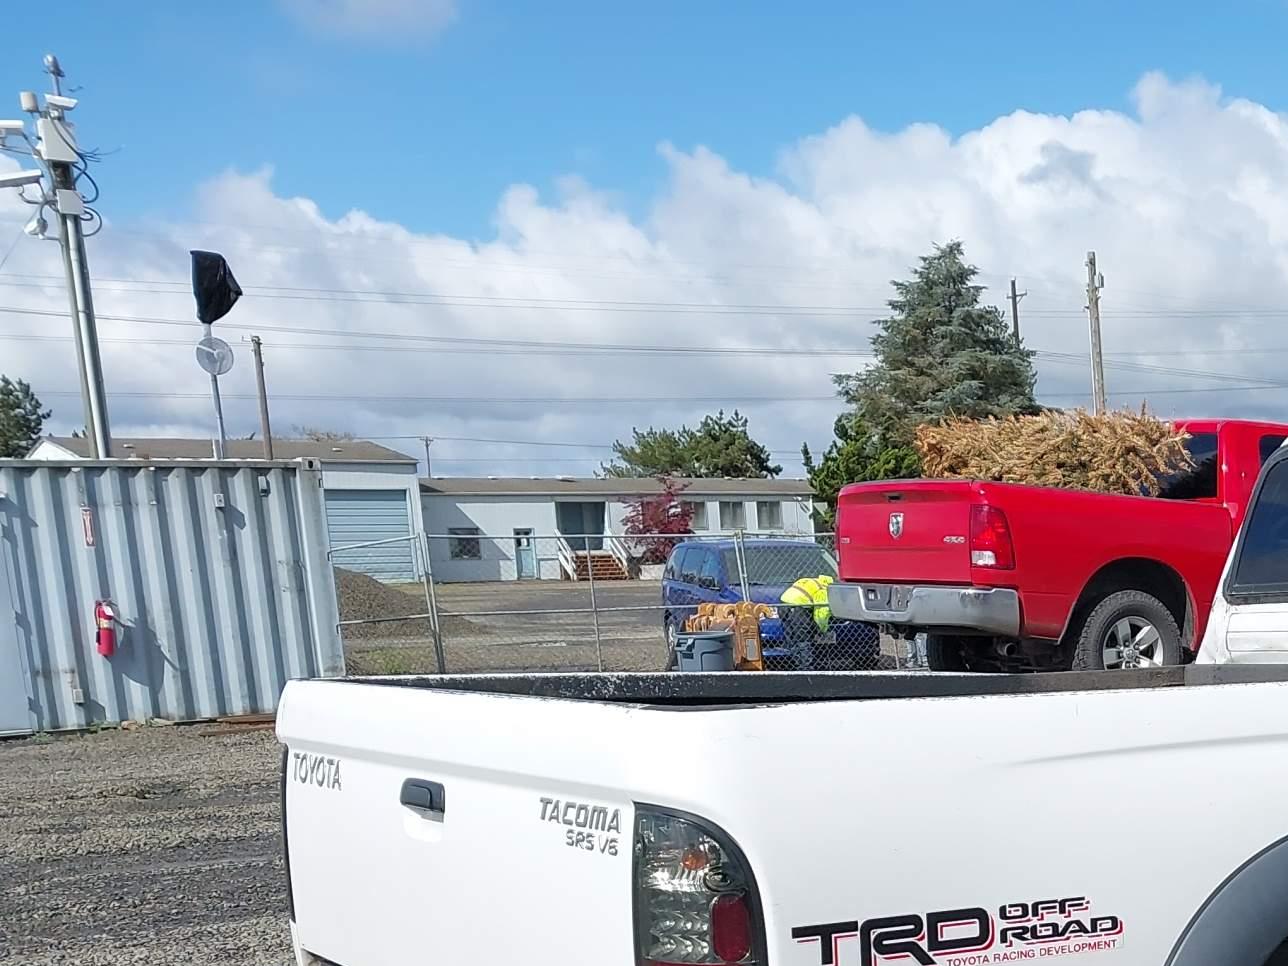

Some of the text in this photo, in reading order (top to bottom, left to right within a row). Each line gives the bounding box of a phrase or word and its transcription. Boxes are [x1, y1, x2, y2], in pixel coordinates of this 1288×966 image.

[293, 752, 342, 791] TOYOTA
[539, 797, 622, 833] TACOMA
[598, 835, 619, 857] V6
[999, 896, 1090, 924] OFF
[1000, 915, 1123, 948] ROAD
[995, 948, 1036, 963] RACING
[1039, 939, 1118, 958] DEVELOPMENT
